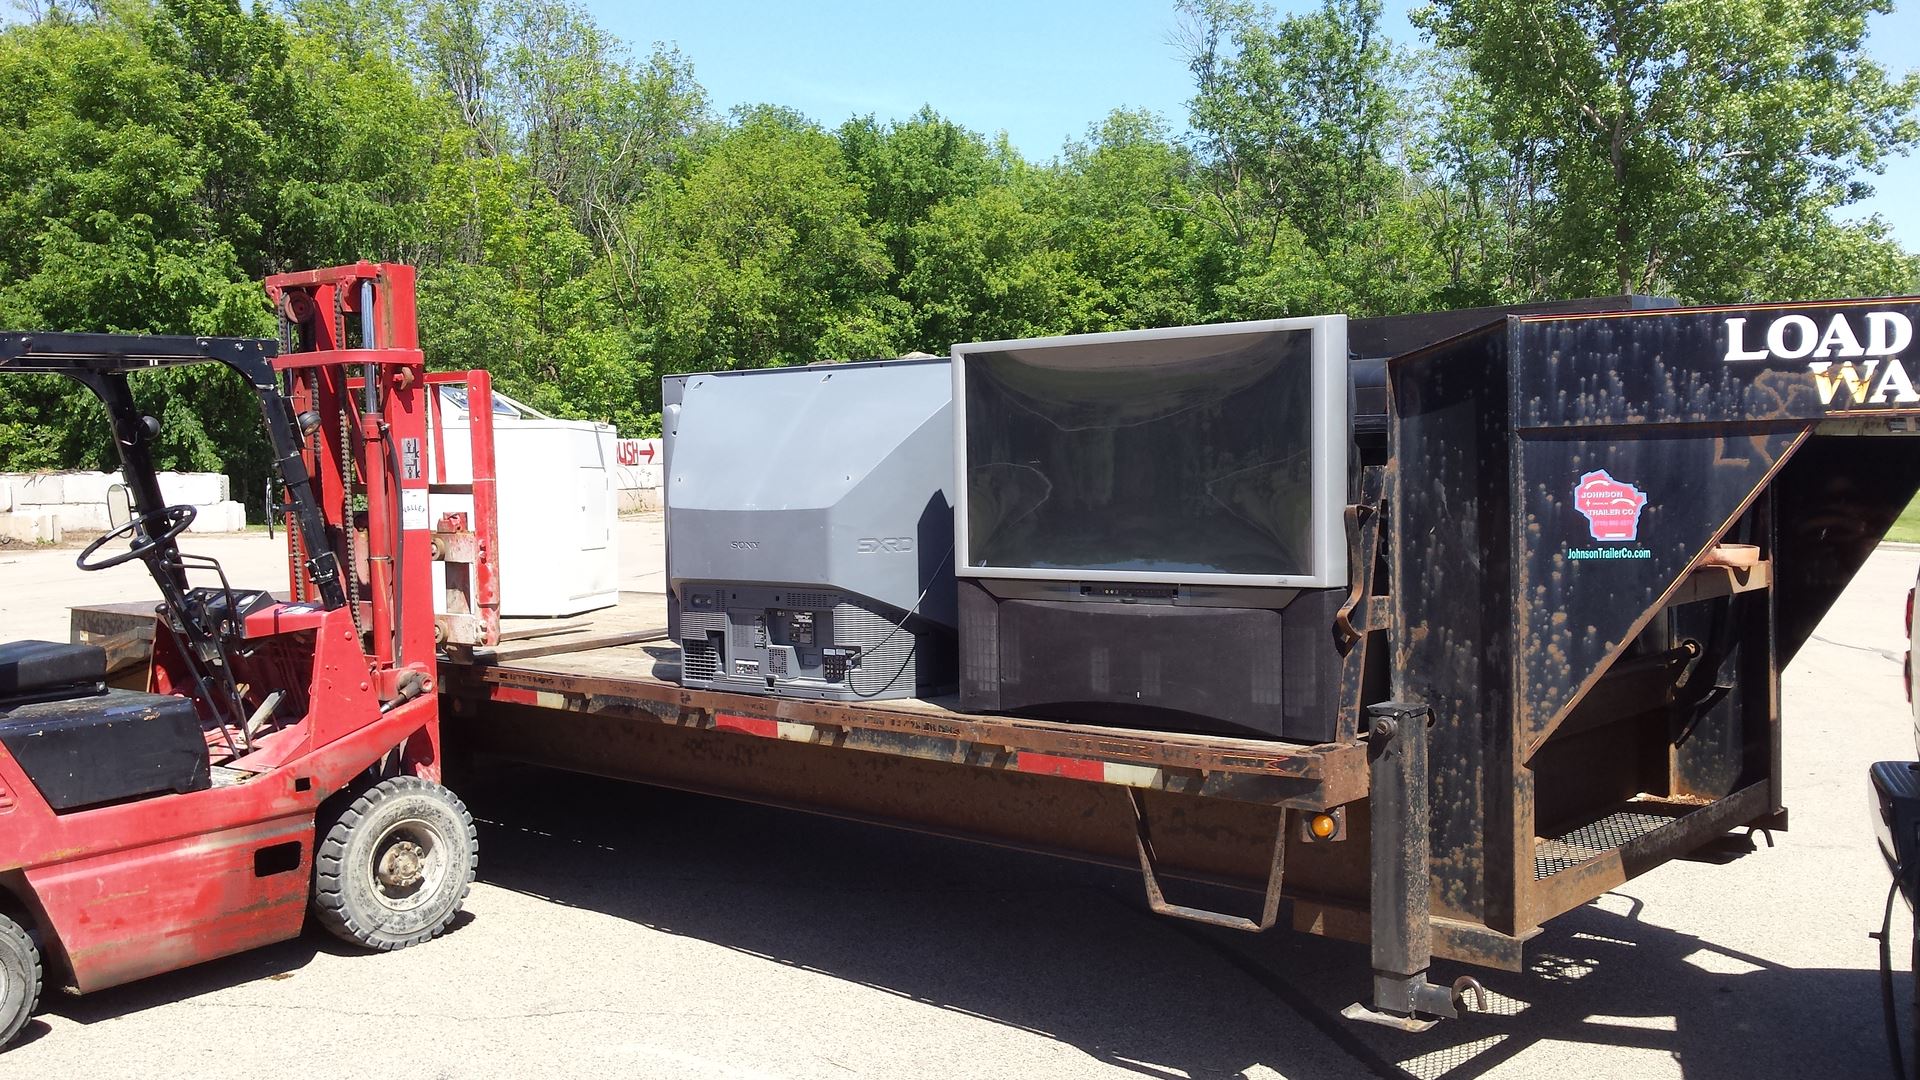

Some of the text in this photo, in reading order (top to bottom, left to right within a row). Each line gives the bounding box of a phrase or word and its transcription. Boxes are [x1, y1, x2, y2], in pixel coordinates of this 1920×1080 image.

[1723, 311, 1913, 361] LOAD
[1581, 491, 1623, 499] JOHNSON
[1588, 508, 1636, 516] TRAILER CO.
[730, 541, 760, 550] SONY
[1567, 547, 1651, 559] JohnsonTrailerCo.com
